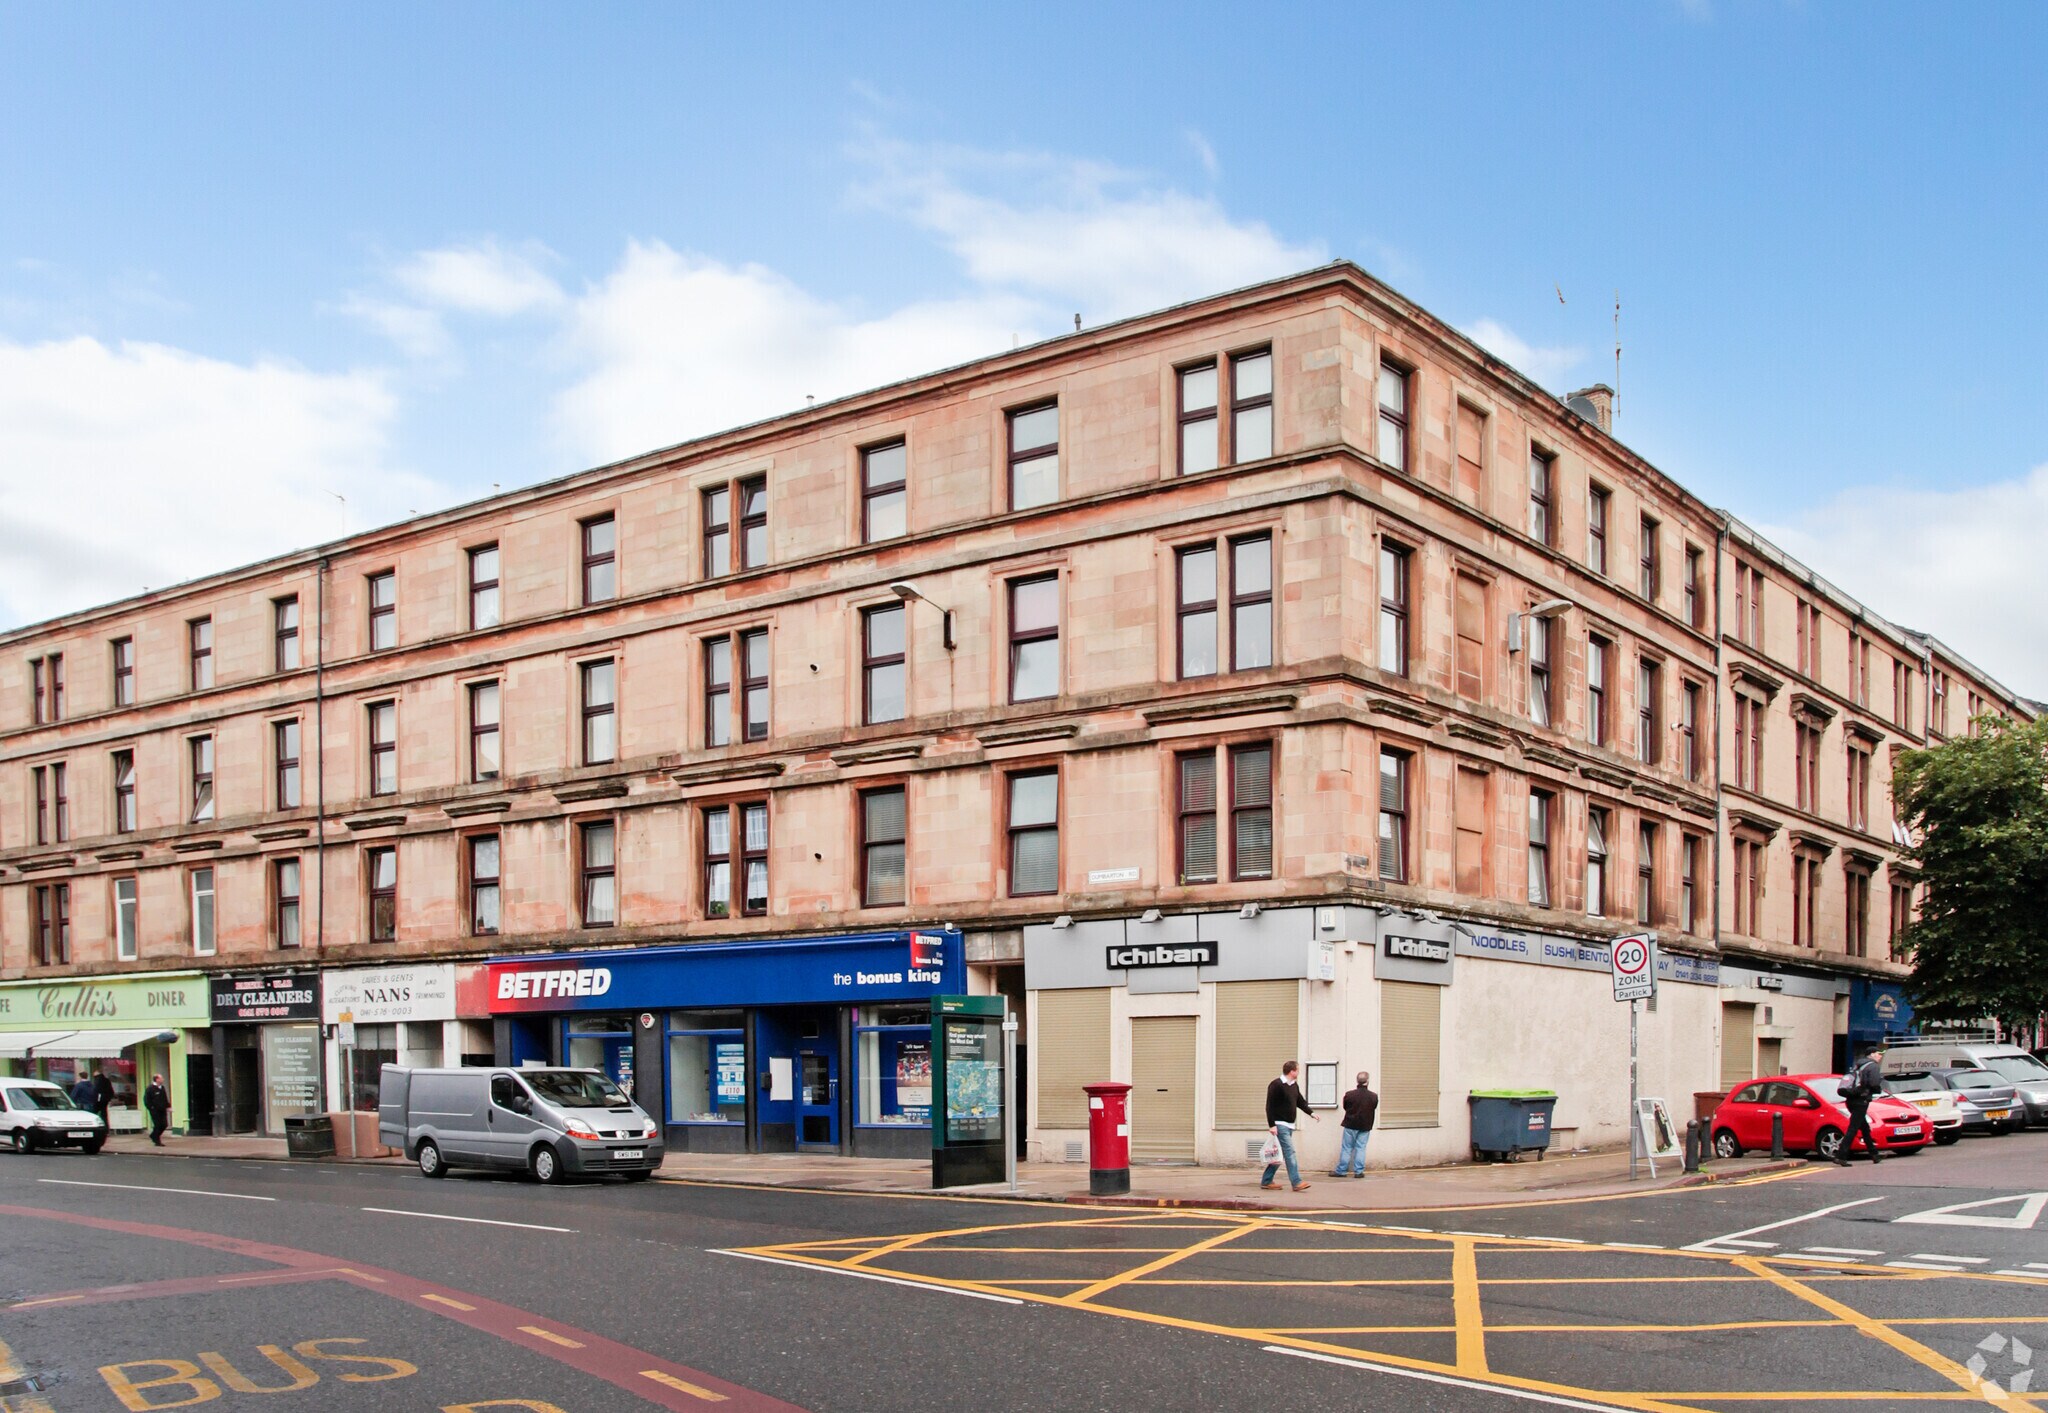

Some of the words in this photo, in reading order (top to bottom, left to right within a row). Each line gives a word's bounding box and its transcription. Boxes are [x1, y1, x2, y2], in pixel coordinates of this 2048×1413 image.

[916, 936, 943, 945] BETFRED
[1471, 935, 1529, 956] NOODLES,
[1109, 946, 1210, 966] Ichiban
[1544, 944, 1578, 961] SUSHI,
[1620, 949, 1642, 965] 20
[1673, 956, 1692, 967] HOME
[1692, 960, 1719, 971] DELIVERY
[390, 973, 414, 982] GENTS
[424, 978, 438, 987] AND
[497, 967, 612, 999] BETFRED
[833, 972, 852, 986] the
[856, 971, 902, 985] bonus
[907, 968, 941, 984] king
[1618, 974, 1647, 986] ZONE
[147, 991, 187, 1007] DINER
[216, 993, 241, 1006] DRY
[241, 990, 314, 1006] CLEANERS
[363, 986, 411, 1003] NANS
[414, 991, 446, 1000] TRIMMINGS
[1618, 989, 1648, 998] Partick
[98, 1337, 419, 1412] BUS
